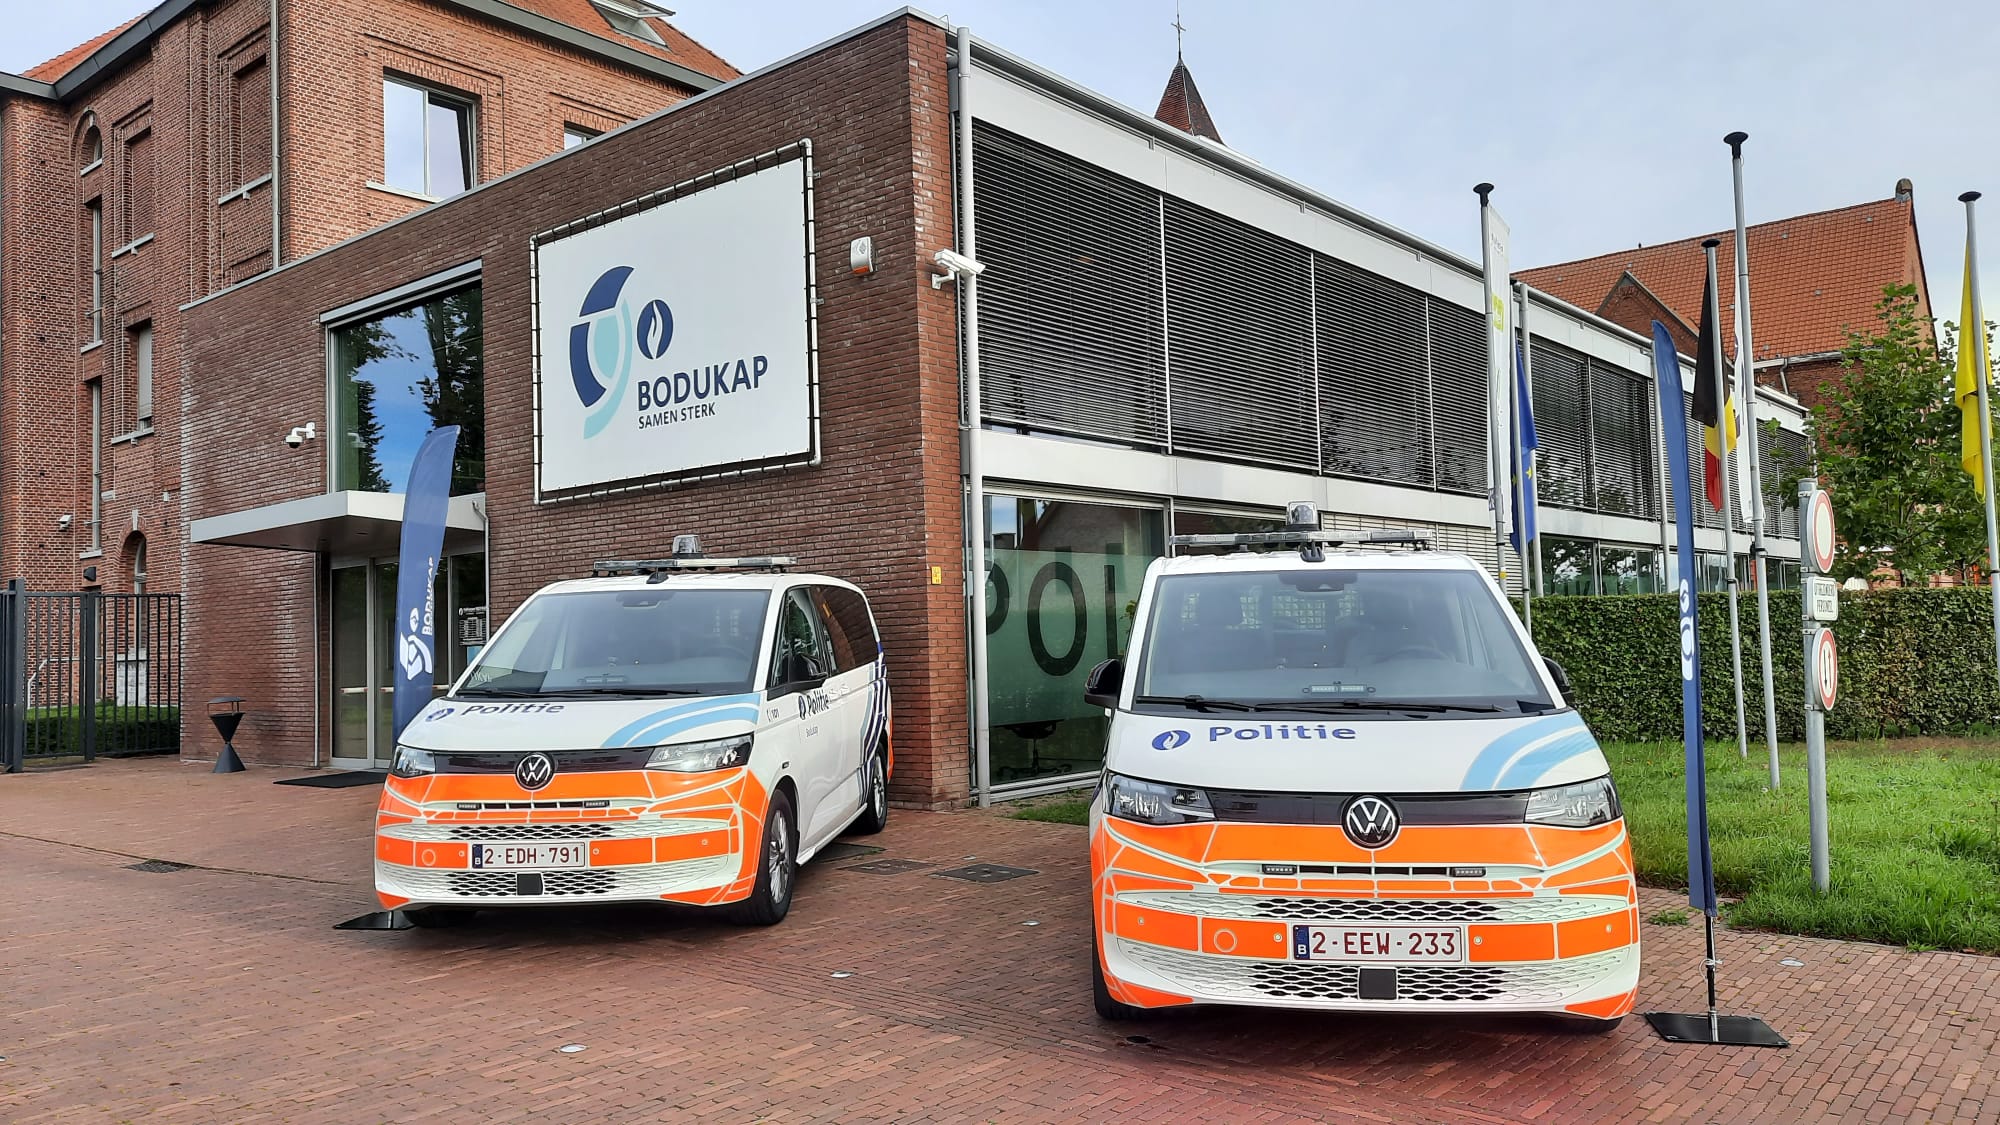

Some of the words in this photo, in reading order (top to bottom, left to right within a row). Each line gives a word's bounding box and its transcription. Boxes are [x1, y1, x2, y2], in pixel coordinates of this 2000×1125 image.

[637, 355, 769, 411] BODUKAP
[638, 411, 678, 430] SAMEN
[681, 402, 716, 421] STERK
[461, 703, 565, 715] Politie
[807, 690, 829, 716] Politie
[1209, 725, 1357, 742] Politie
[484, 846, 579, 865] 2-EDH-791
[1297, 944, 1307, 956] B
[1312, 931, 1455, 955] 2-EEW-233
